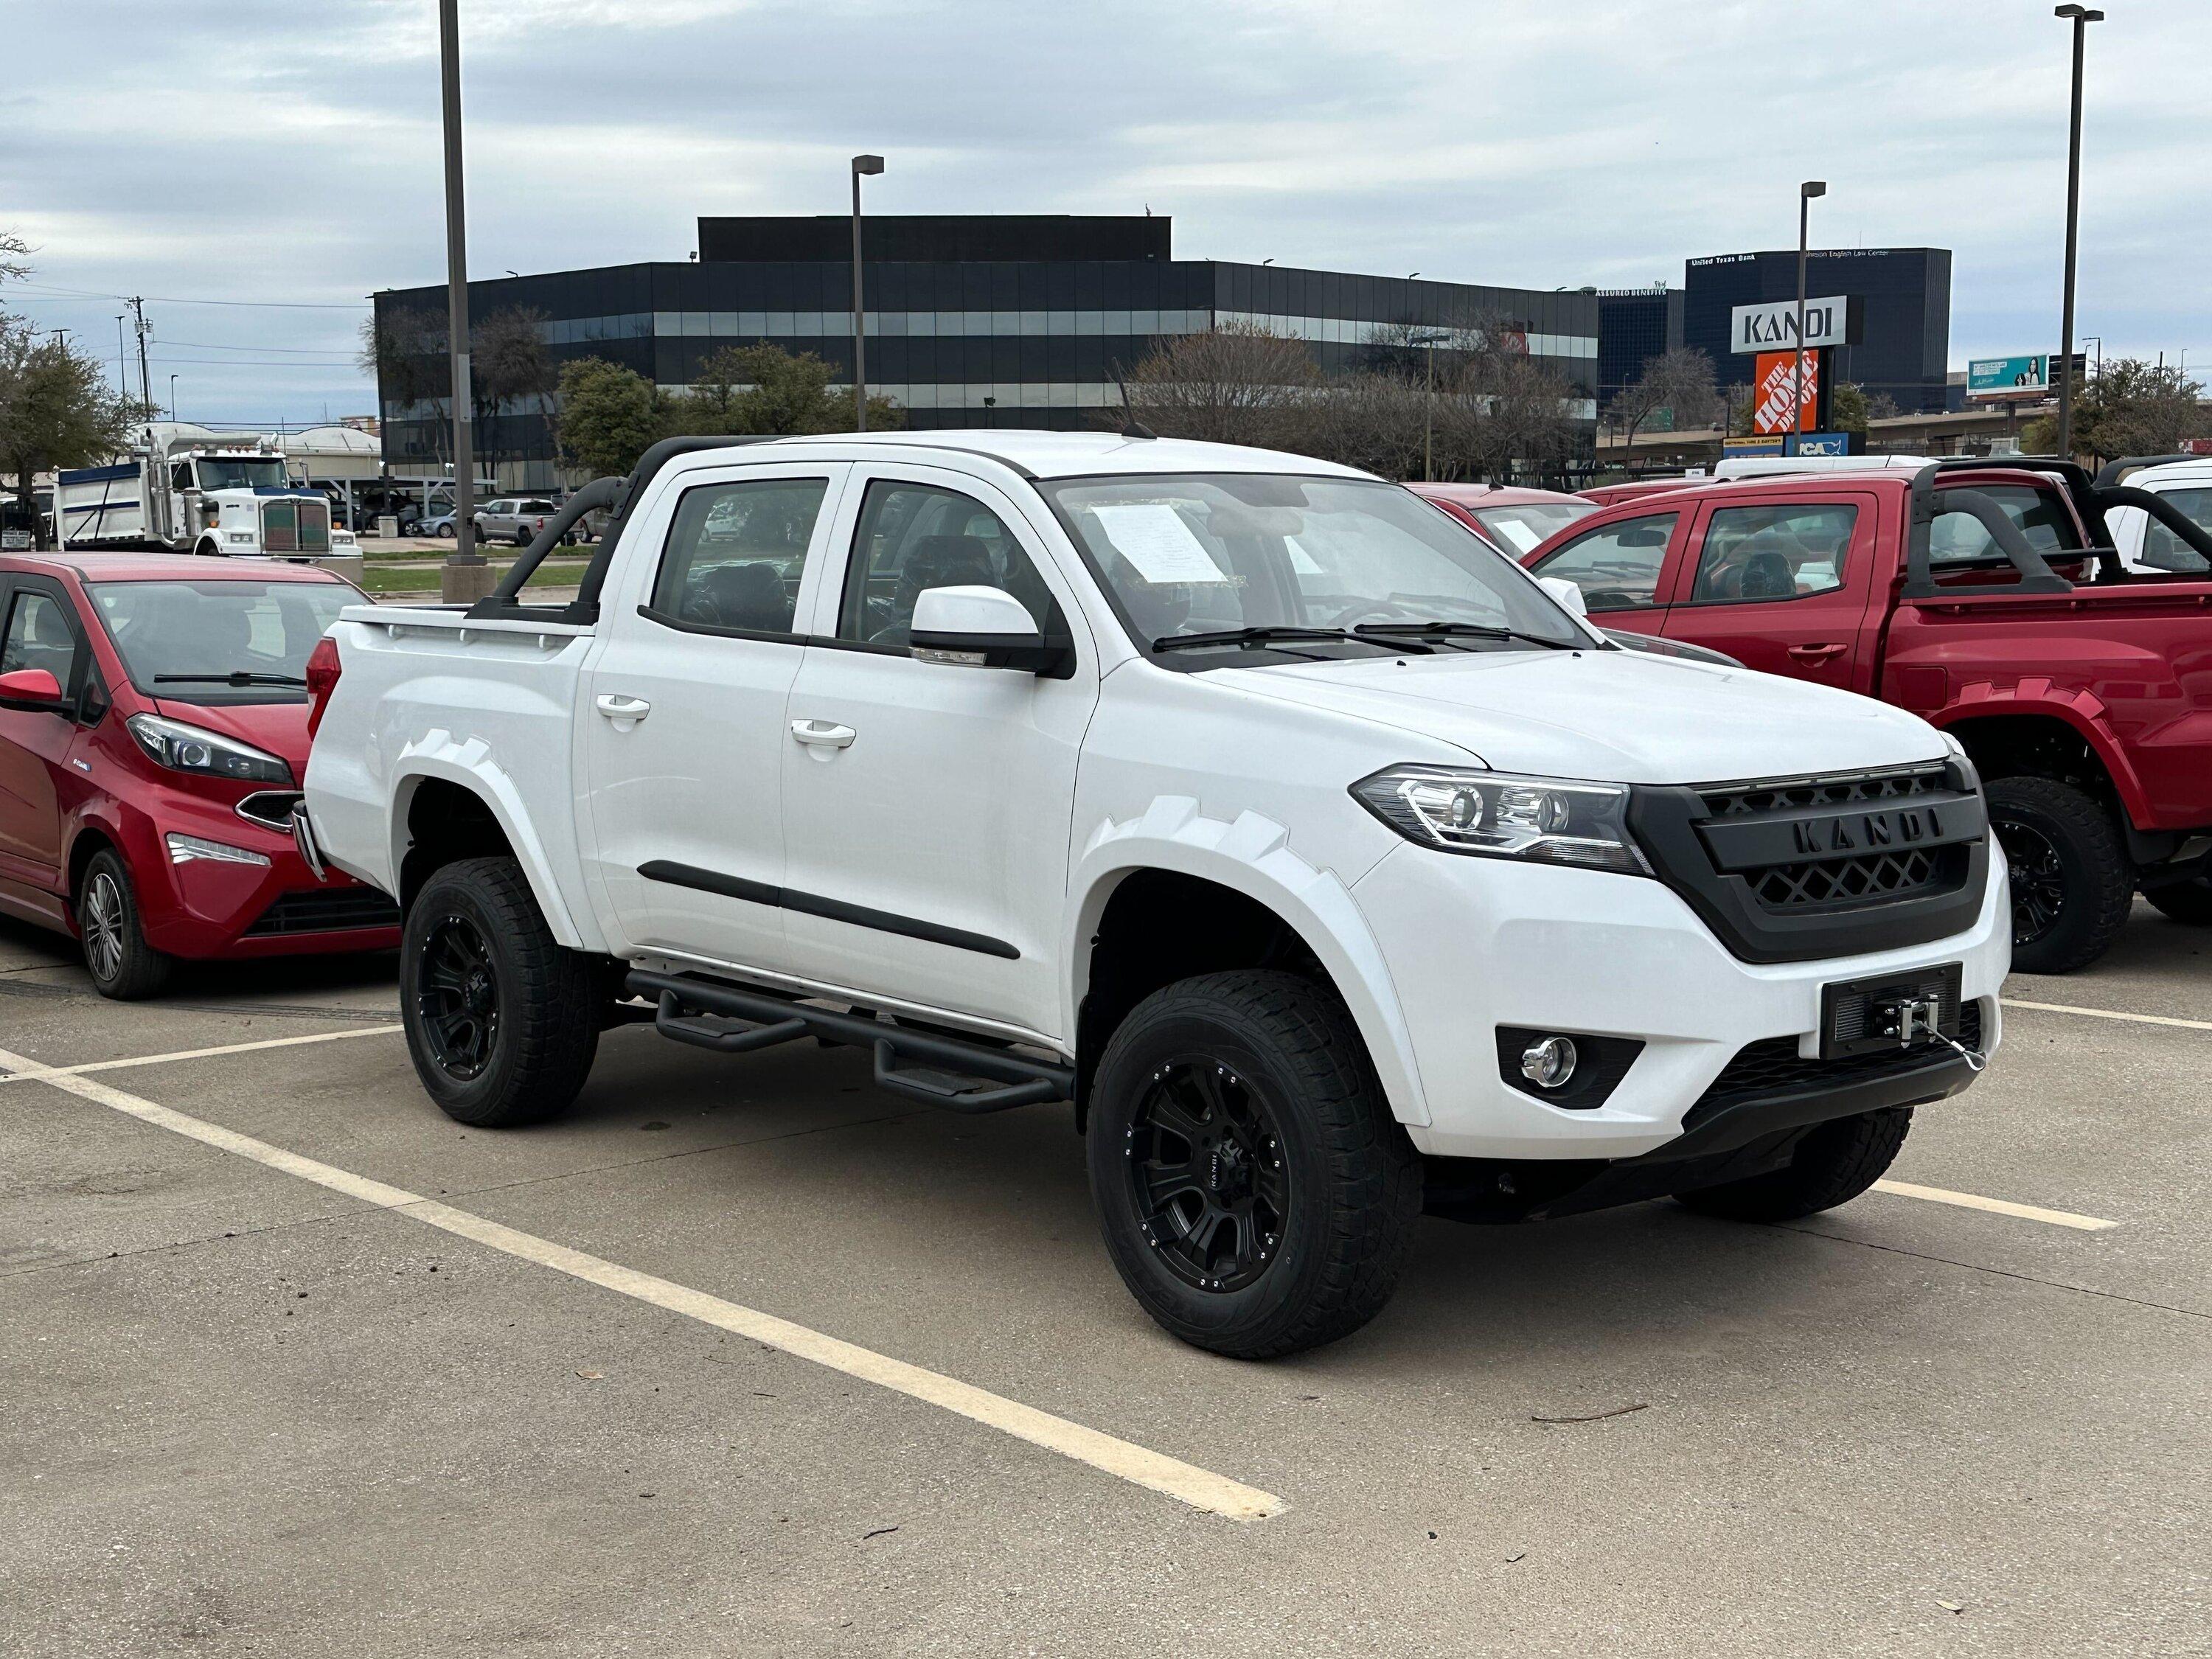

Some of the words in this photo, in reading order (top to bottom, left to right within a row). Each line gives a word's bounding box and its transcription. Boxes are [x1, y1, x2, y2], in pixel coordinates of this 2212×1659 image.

[1745, 307, 1832, 344] KANDI
[1754, 350, 1819, 434] HOME
[1761, 361, 1788, 394] THE
[1777, 379, 1818, 433] DEOT
[1795, 807, 1944, 854] KANDI
